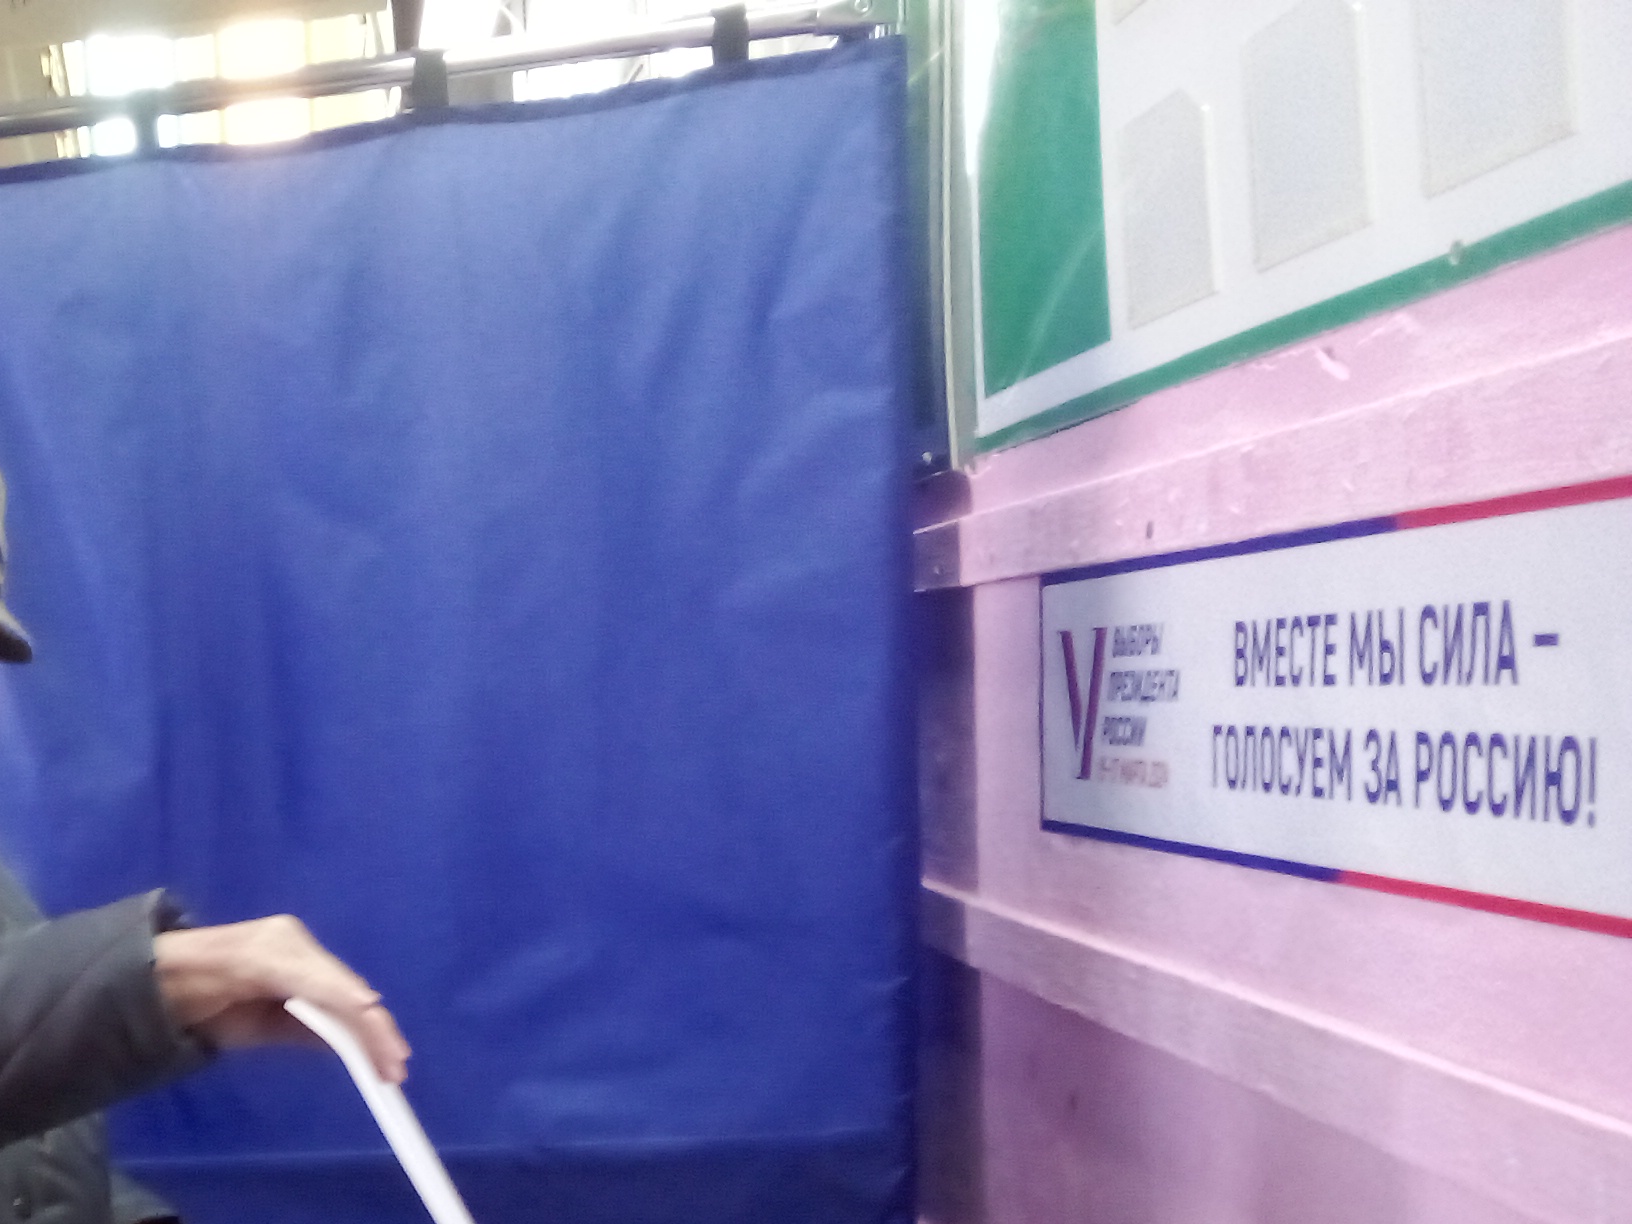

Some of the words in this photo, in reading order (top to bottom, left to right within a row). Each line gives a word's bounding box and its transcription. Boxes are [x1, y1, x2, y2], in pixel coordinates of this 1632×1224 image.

[1234, 614, 1338, 687] ВМЕСТЕ
[1349, 606, 1405, 687] МЫ
[1419, 600, 1519, 686] СИЛА
[1212, 724, 1352, 801] ГОЛОСУЕМ
[1364, 728, 1402, 807] ЗА
[1415, 730, 1597, 828] РОССИЮ!
